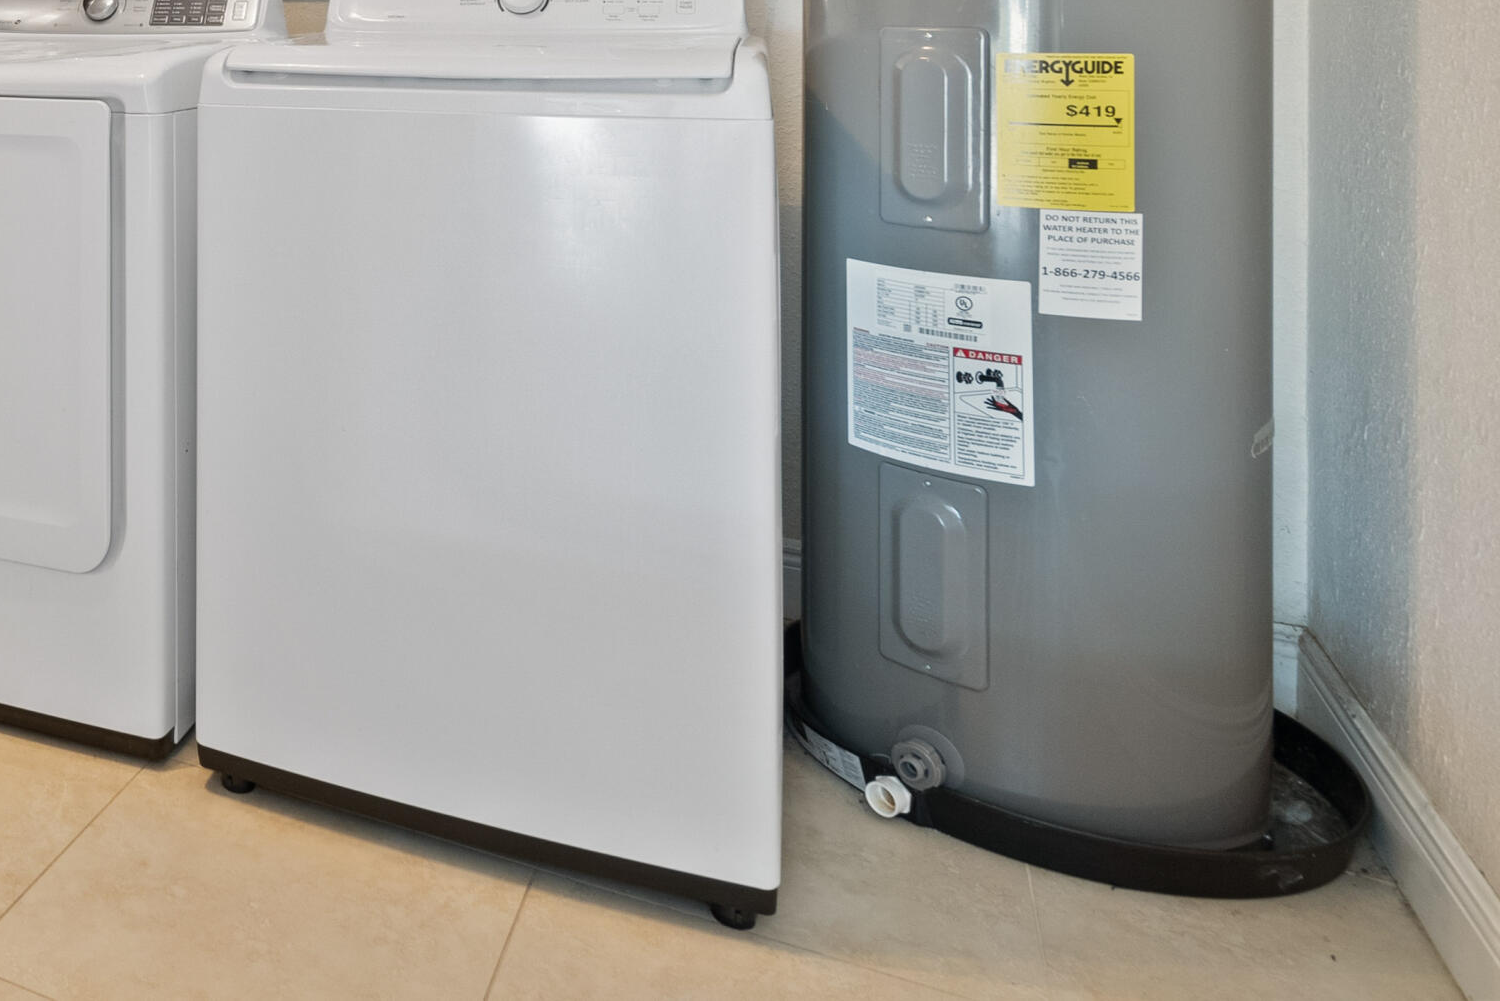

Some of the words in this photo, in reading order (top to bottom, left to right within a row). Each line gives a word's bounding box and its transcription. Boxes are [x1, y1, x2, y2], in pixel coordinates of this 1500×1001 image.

[1045, 214, 1060, 222] DO
[1061, 215, 1081, 224] NOT
[1082, 216, 1117, 225] RETURN
[1119, 218, 1138, 226] THIS
[1043, 224, 1073, 232] WATER
[1075, 226, 1109, 235] HEATER
[1124, 228, 1140, 236] THE
[1047, 234, 1074, 243] PLACE
[1076, 236, 1088, 244] OF
[1090, 237, 1136, 246] PURCHASE
[1041, 266, 1141, 282] 1-866-279-4566
[967, 348, 1019, 365] DANGER
